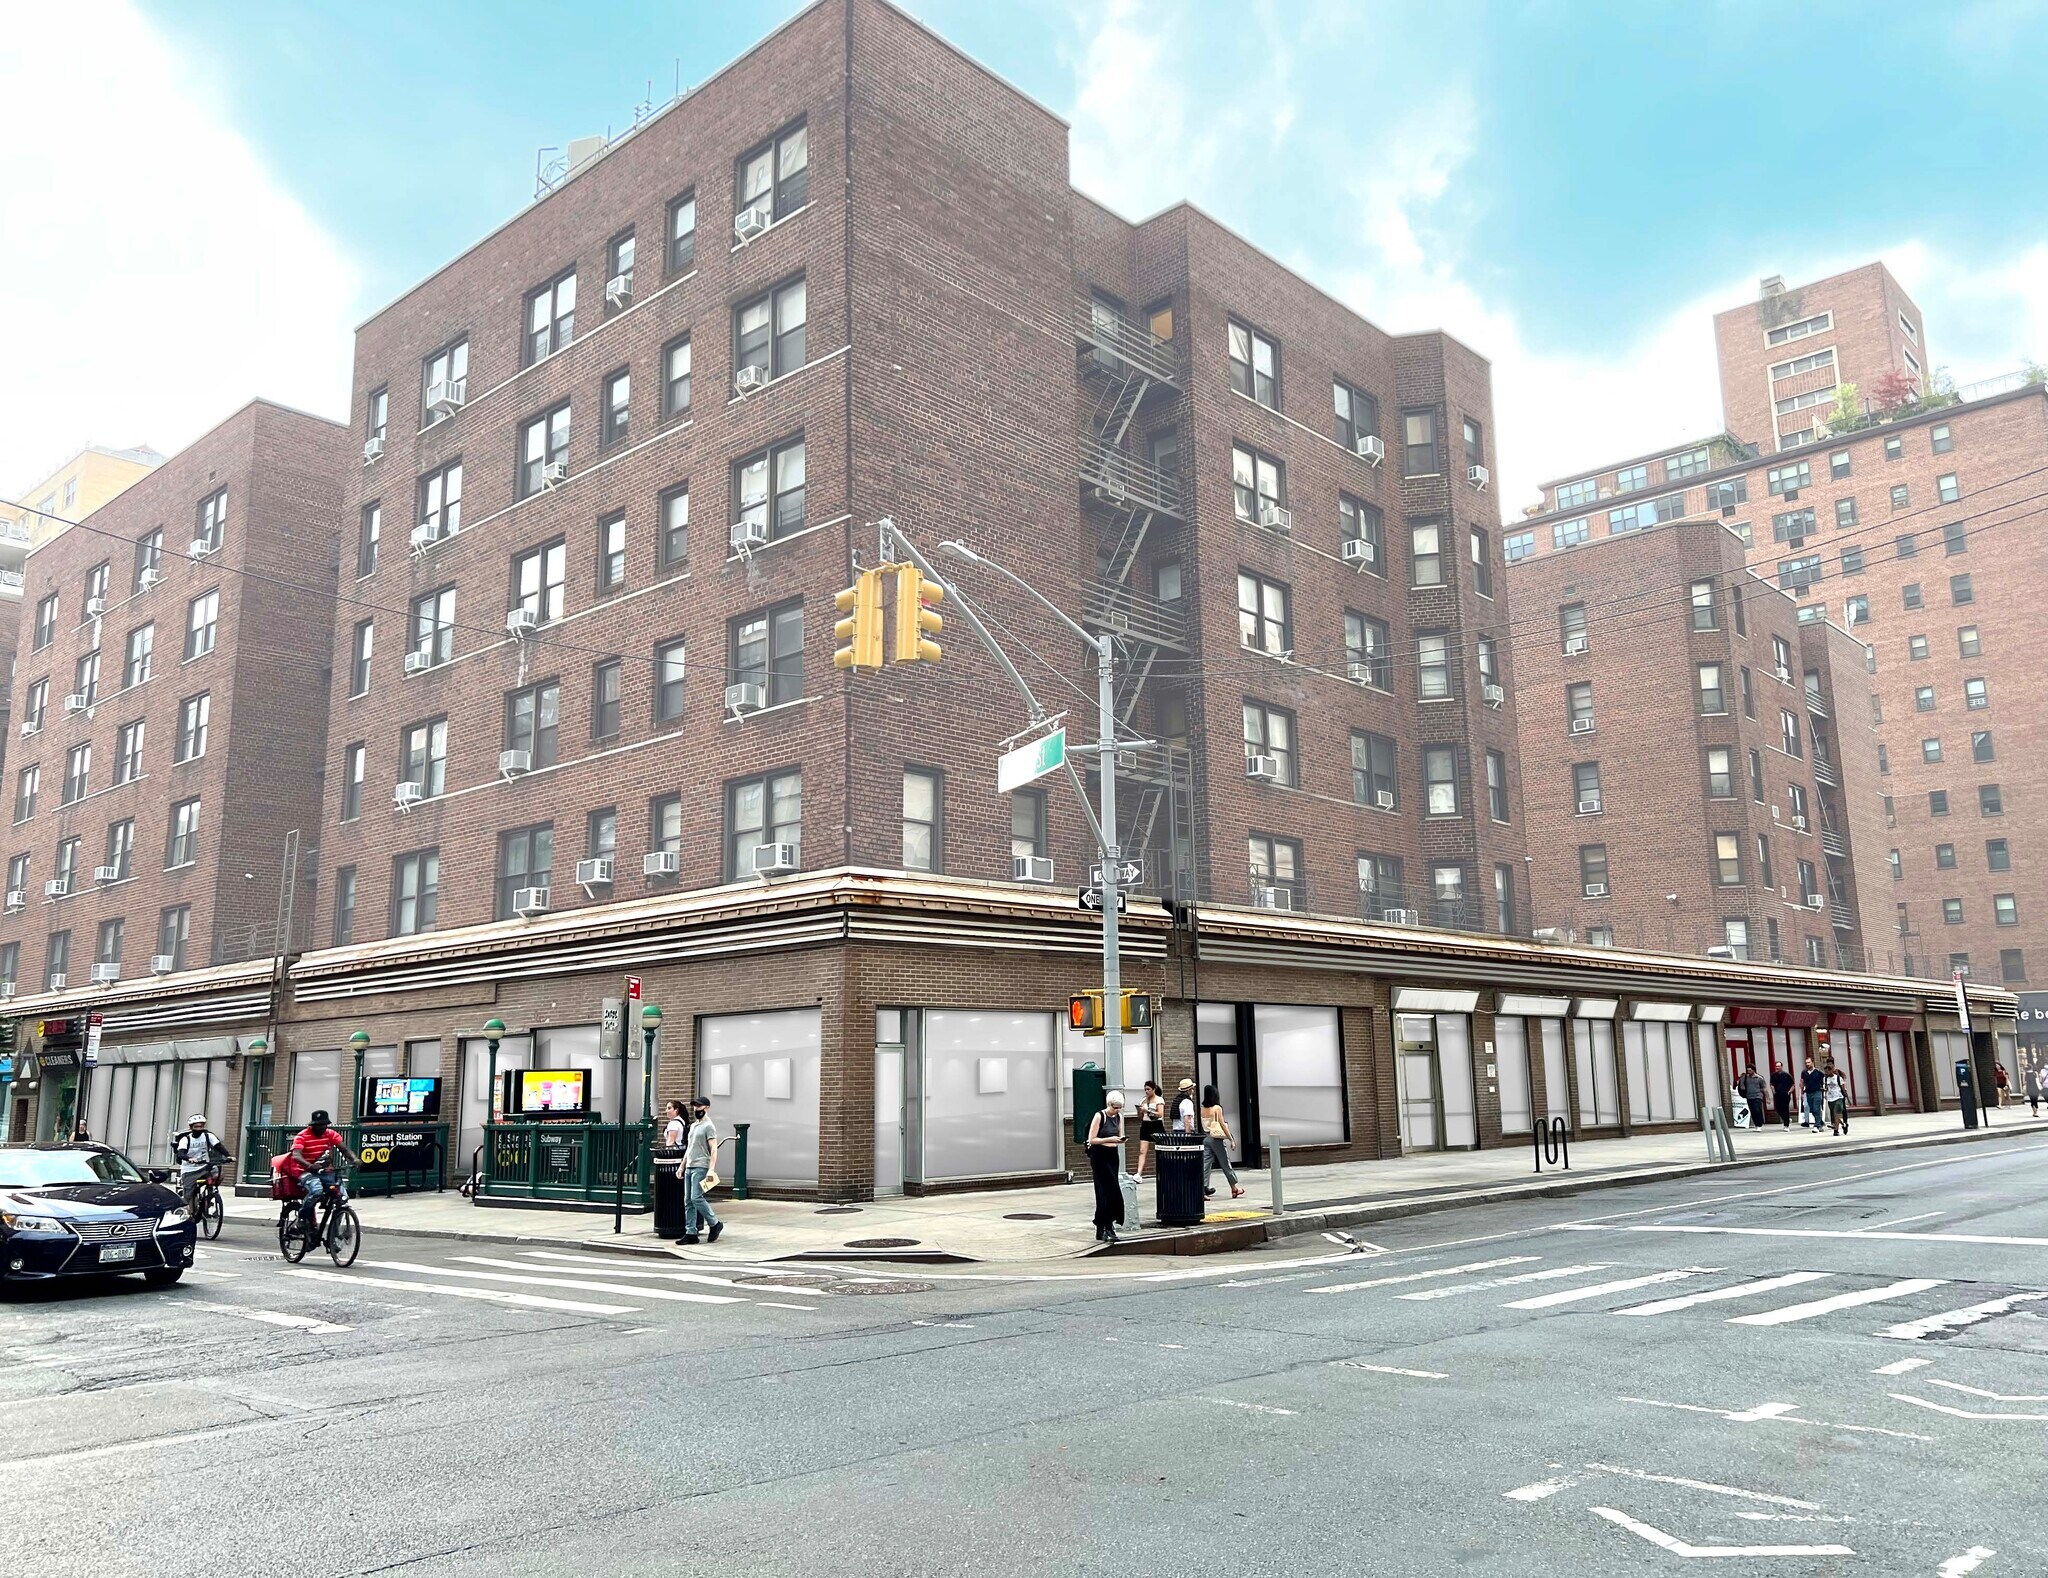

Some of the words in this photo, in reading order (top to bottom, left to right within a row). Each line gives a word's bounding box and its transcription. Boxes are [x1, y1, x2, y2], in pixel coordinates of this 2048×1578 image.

[1086, 894, 1100, 904] ONE
[45, 1054, 73, 1066] CLEANERS
[541, 1134, 562, 1144] Subway
